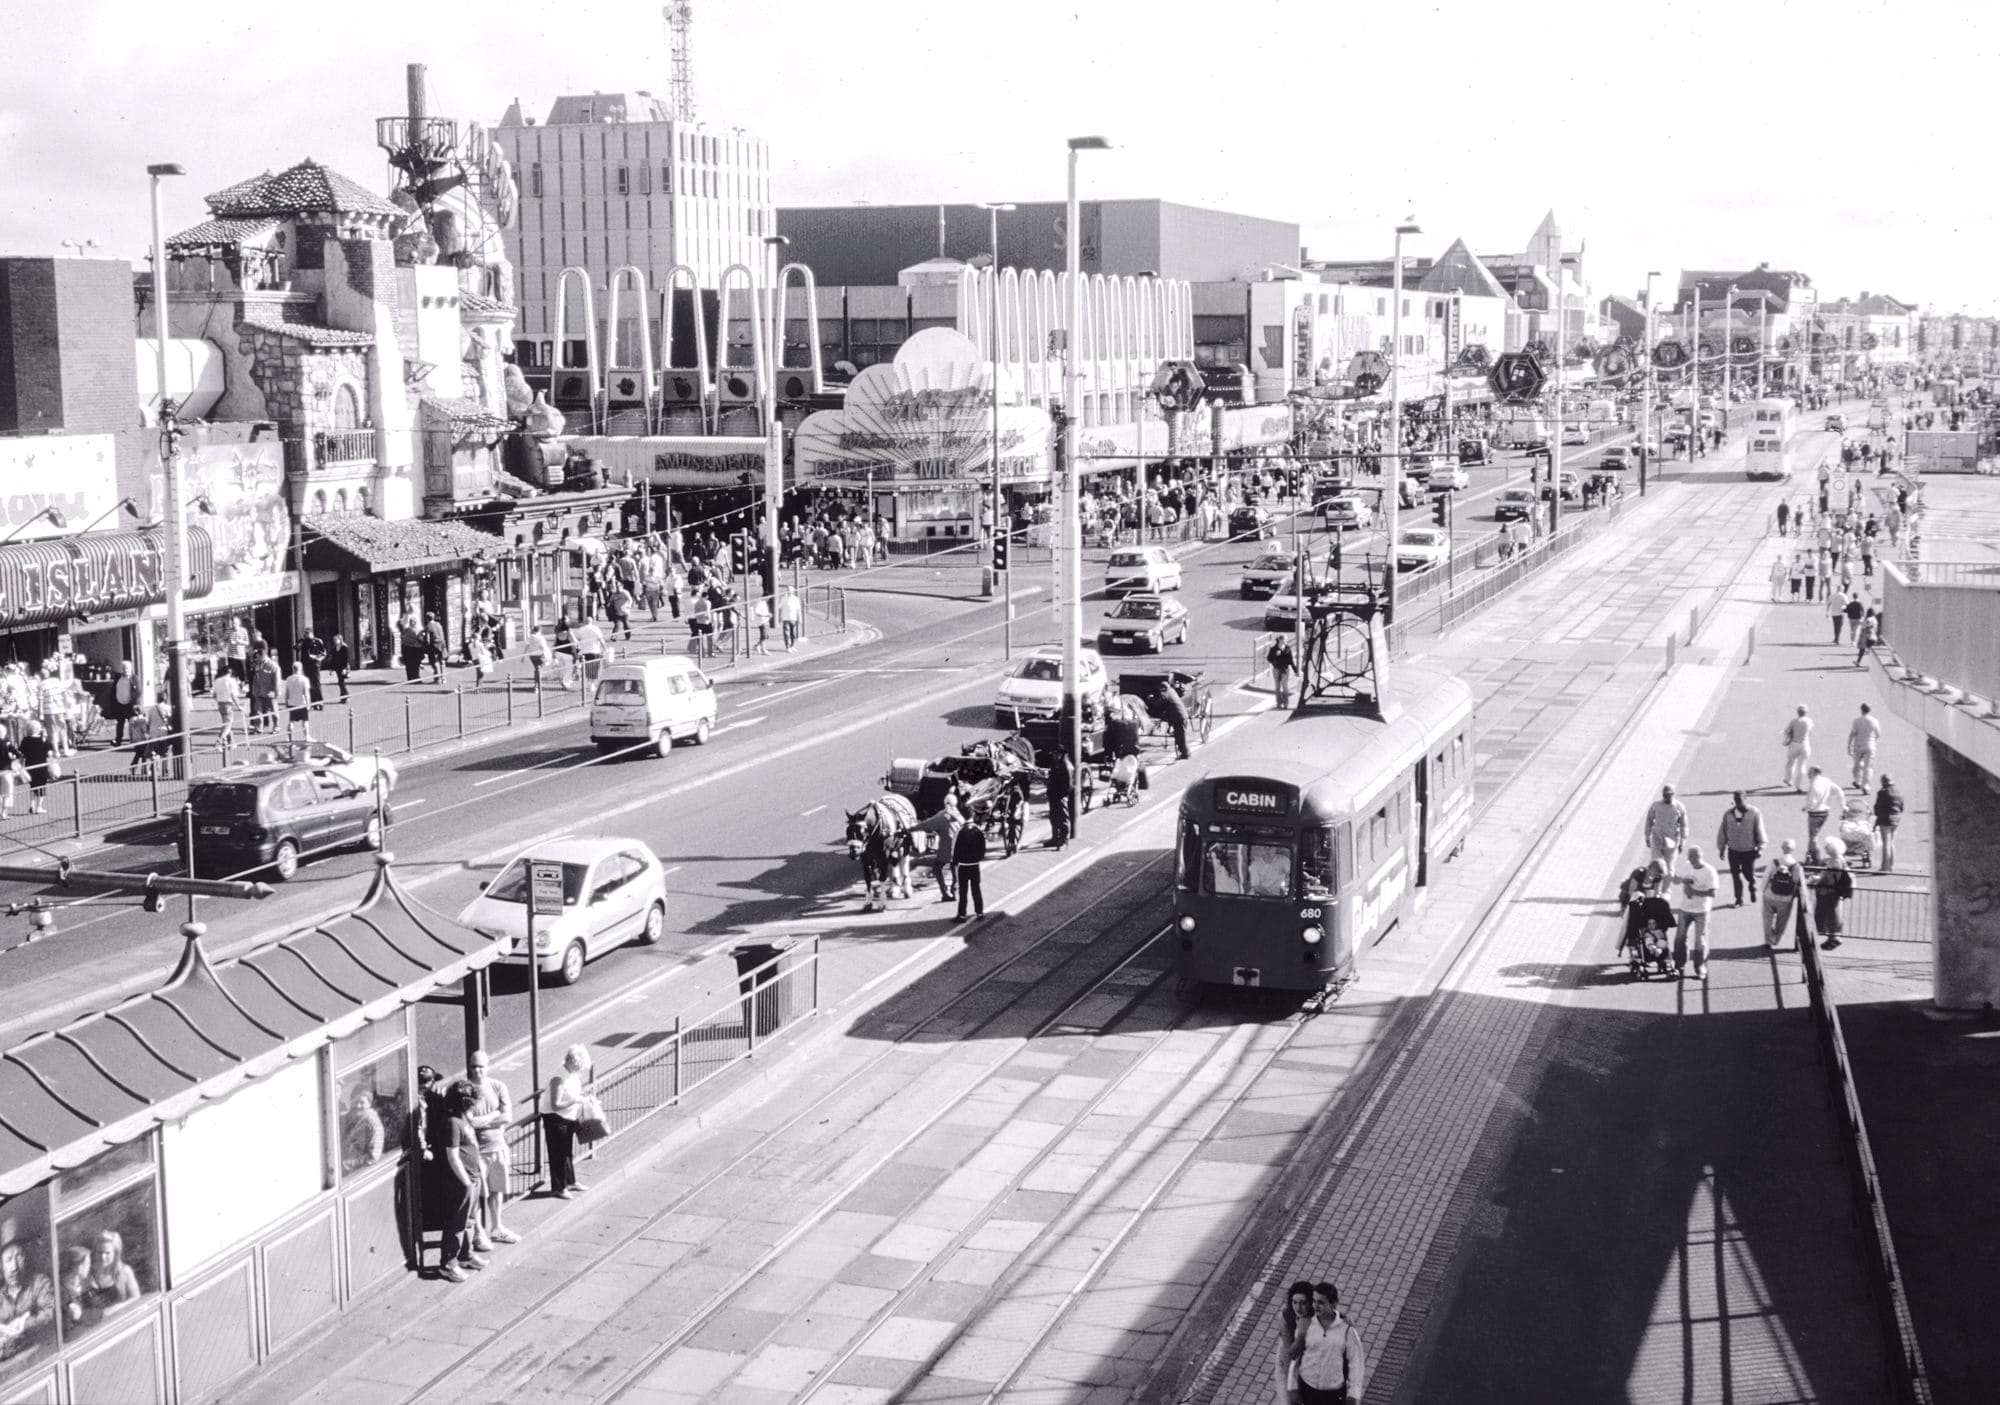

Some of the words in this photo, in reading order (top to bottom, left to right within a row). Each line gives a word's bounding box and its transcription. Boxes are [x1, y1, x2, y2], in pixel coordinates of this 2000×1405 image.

[814, 458, 896, 482] GOLDEN
[23, 549, 168, 611] ISLAN
[1226, 792, 1276, 808] CABIN
[1300, 908, 1322, 918] 680
